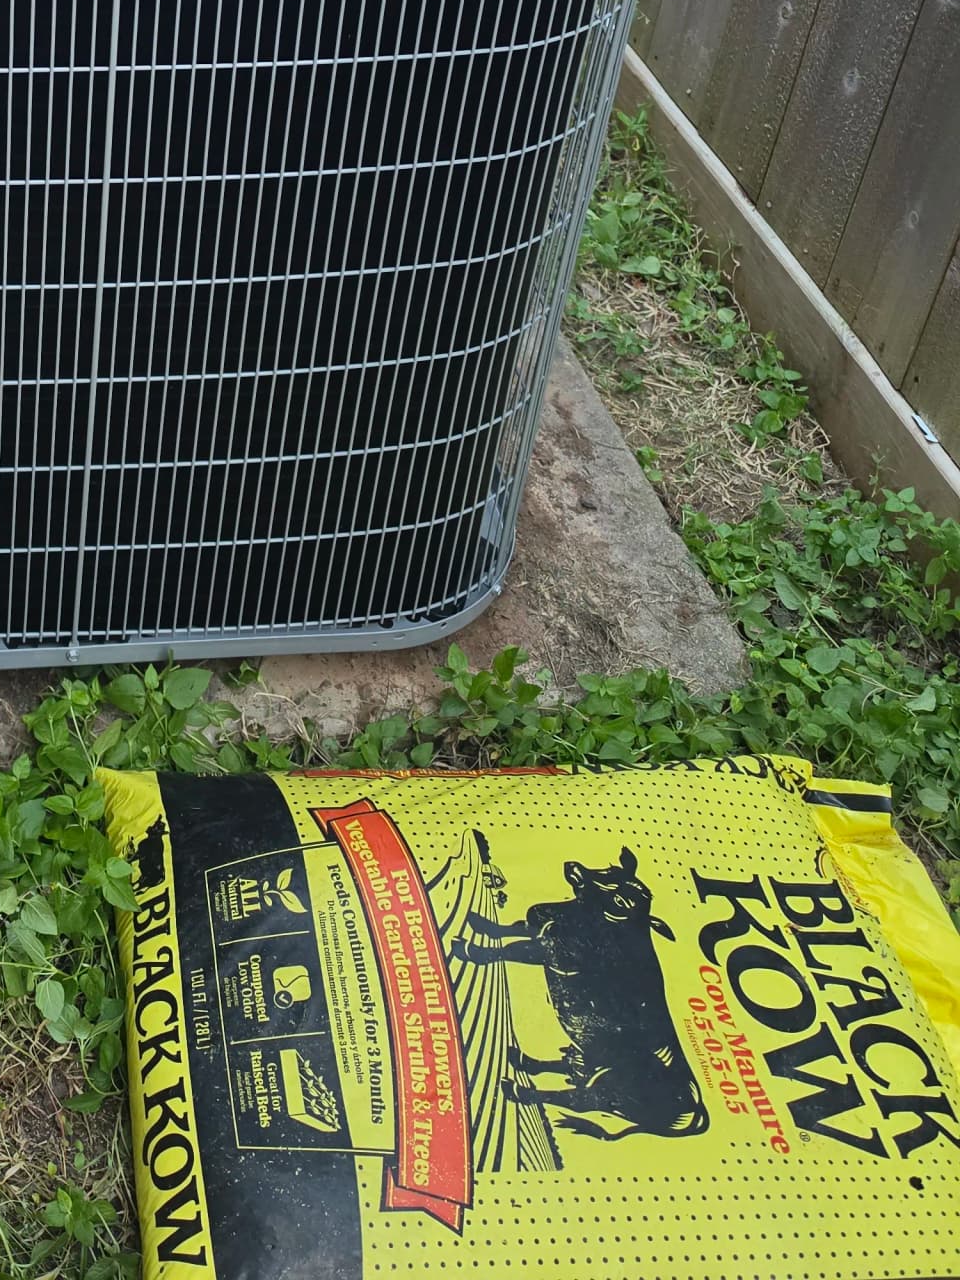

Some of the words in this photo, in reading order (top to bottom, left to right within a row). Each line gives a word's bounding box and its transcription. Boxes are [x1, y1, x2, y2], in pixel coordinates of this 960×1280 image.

[327, 863, 351, 907] Feeds
[344, 819, 392, 911] Vegetable
[228, 878, 243, 920] Natural
[239, 877, 261, 918] ALL
[327, 900, 335, 911] De
[329, 911, 341, 949] hermosas
[238, 961, 249, 986] Low
[342, 909, 376, 1018] Continuously
[382, 914, 416, 1008] Gardens,
[131, 886, 183, 1085] BLACK
[241, 988, 254, 1019] Odor
[250, 954, 270, 1022] Composted
[390, 869, 416, 906] For
[403, 909, 447, 1015] Beautiful
[429, 1019, 454, 1116] Flowers,
[323, 946, 339, 1007] continuamente
[333, 1007, 345, 1040] durante
[341, 1048, 351, 1073] meses
[345, 1010, 357, 1043] arbustos
[365, 1018, 379, 1044] for
[690, 867, 891, 1160] KOW
[768, 875, 960, 1160] BLACK
[349, 1044, 358, 1053] y
[367, 1047, 381, 1057] 3
[404, 1012, 431, 1094] Shrubs
[688, 997, 750, 1115] 0.5-0.5-0.5
[699, 965, 736, 1029] Cow
[723, 1031, 790, 1154] Manure
[250, 1050, 267, 1094] Raised
[267, 1062, 280, 1093] Great
[368, 1059, 386, 1125] Months
[257, 1095, 272, 1128] Beds
[271, 1095, 282, 1112] for
[411, 1098, 431, 1114] &
[142, 1076, 209, 1269] KOW
[412, 1118, 433, 1186] Trees
